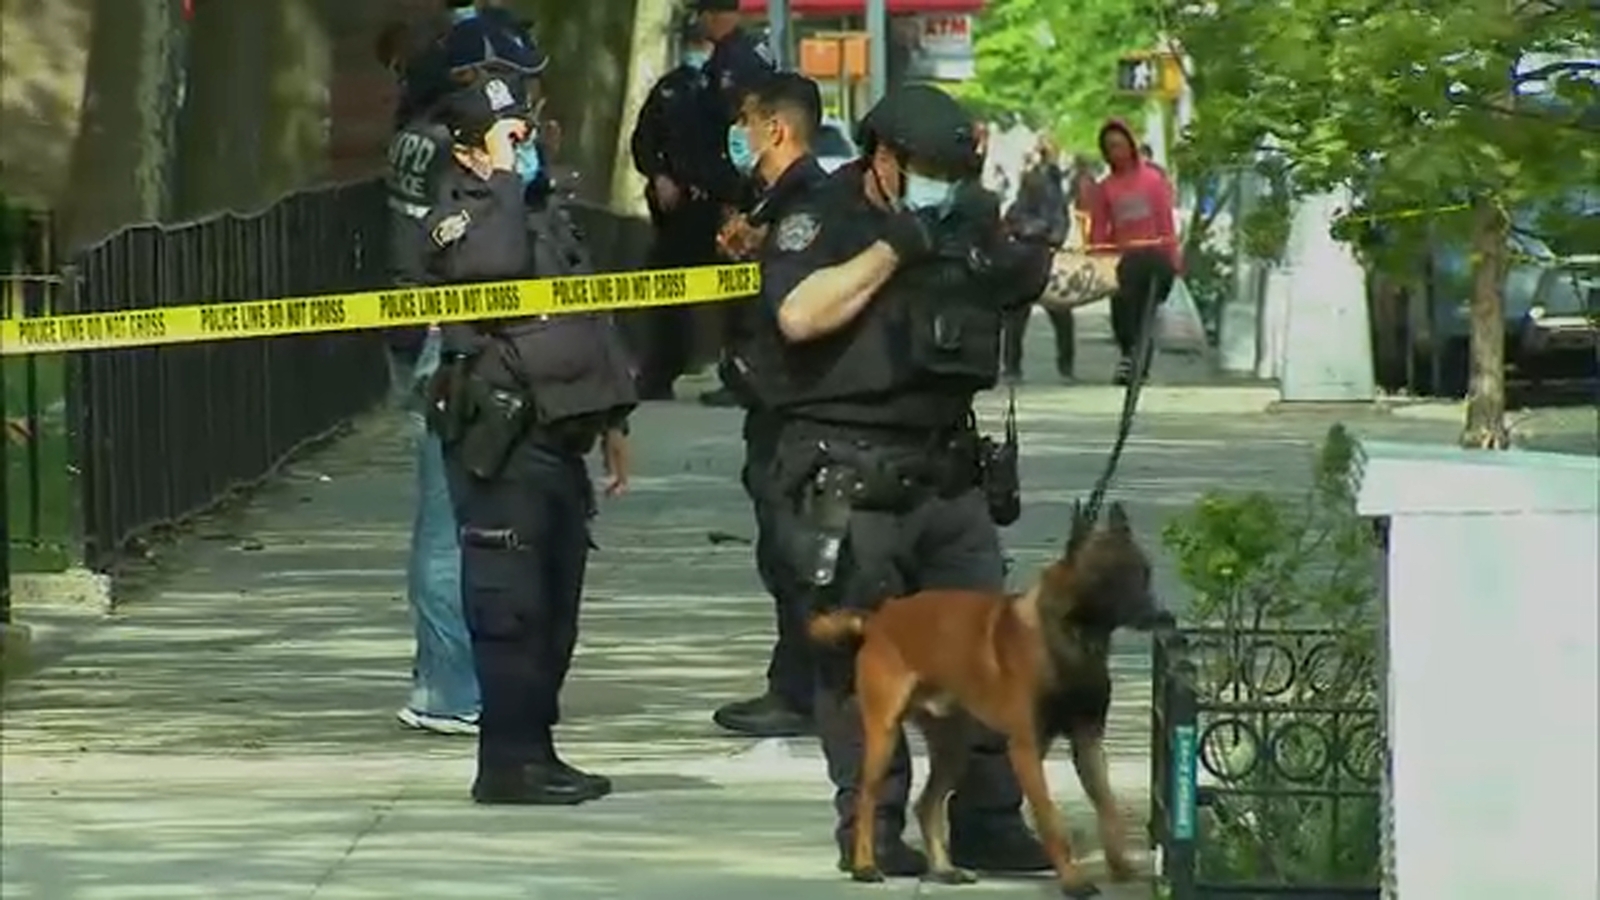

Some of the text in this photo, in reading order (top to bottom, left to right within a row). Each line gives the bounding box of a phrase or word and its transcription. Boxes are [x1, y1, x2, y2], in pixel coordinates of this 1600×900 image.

[925, 16, 967, 36] ATM
[552, 272, 687, 306] POLICE LINE DO NOT CROSS
[717, 267, 750, 295] POLICE
[201, 298, 345, 332] POLICE LINE DO NOT CROSS
[379, 285, 520, 319] POLICE LINE DO NOT CROSS
[19, 311, 166, 345] POLICE LINE DO NOT CROSS
